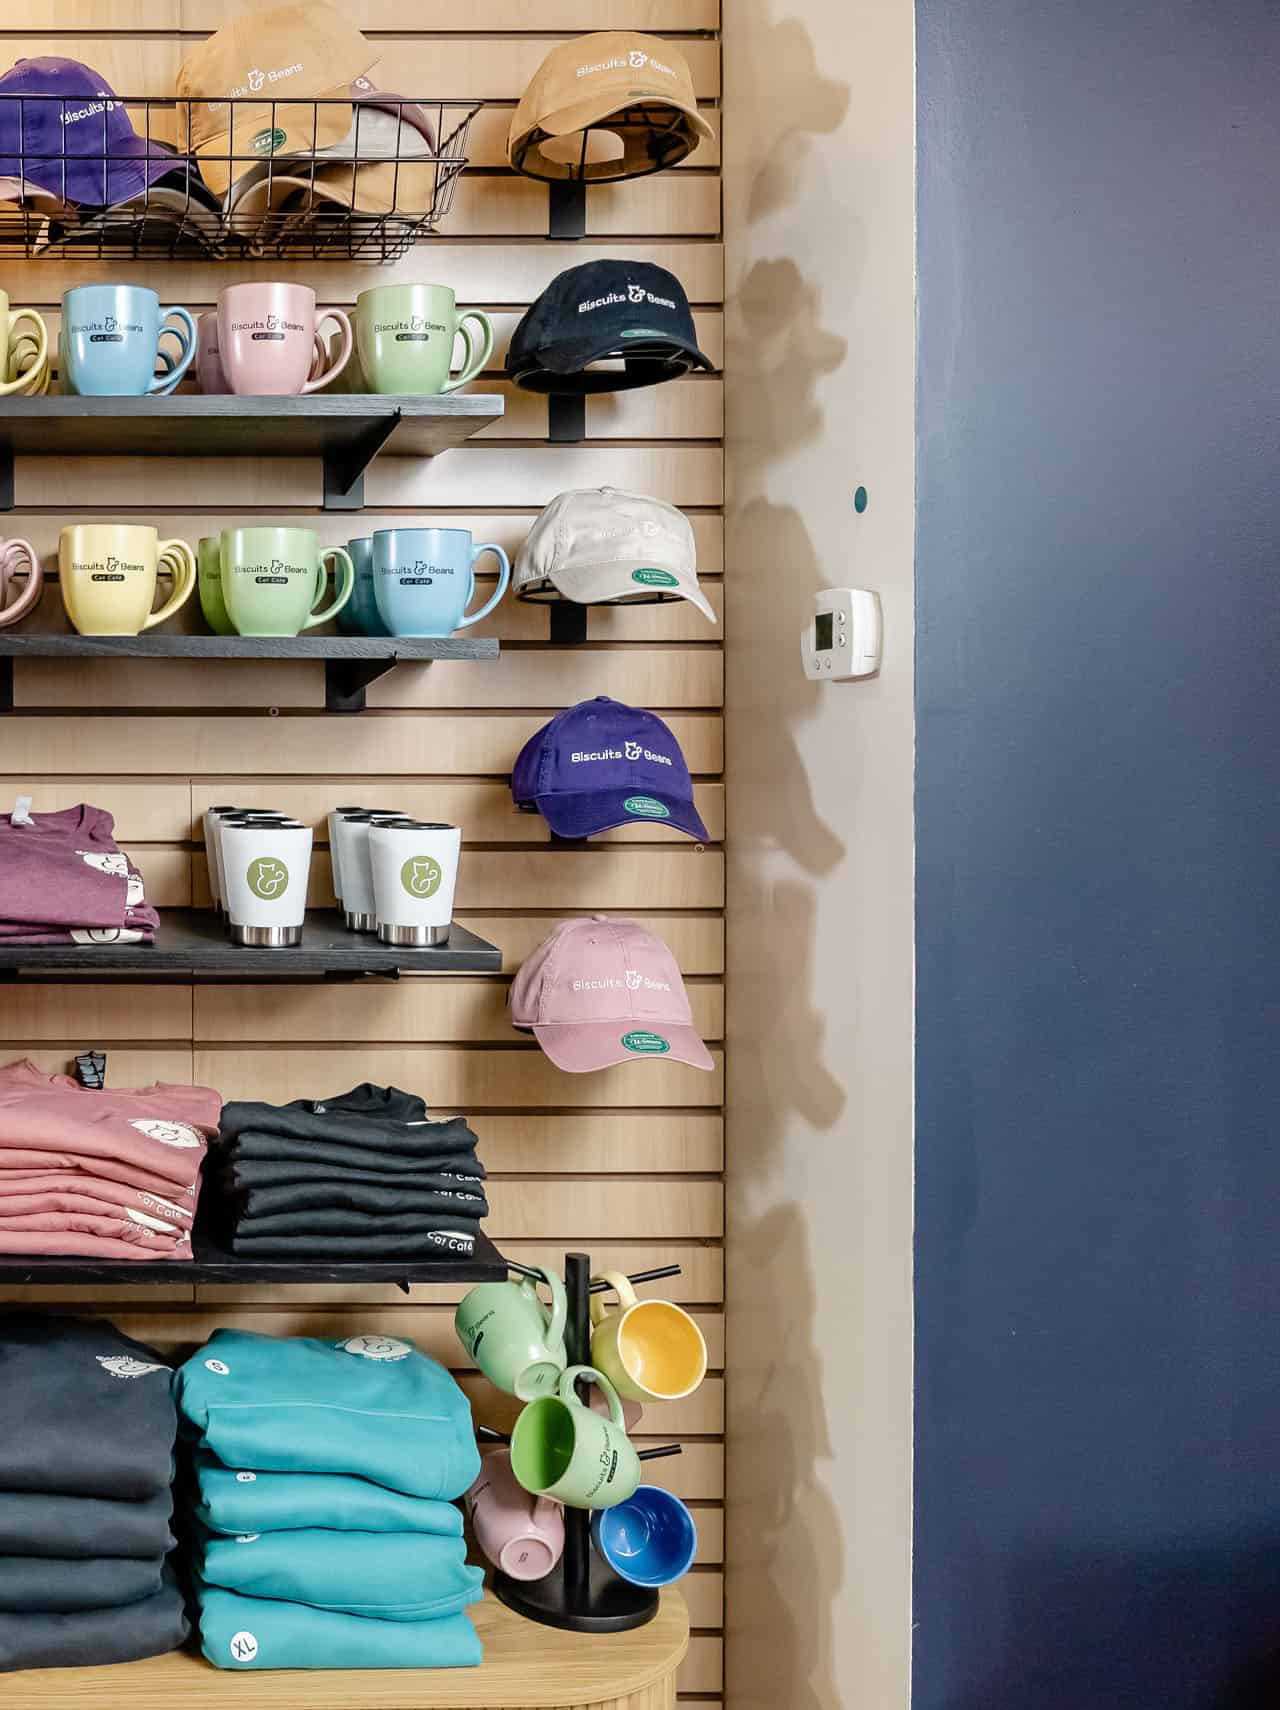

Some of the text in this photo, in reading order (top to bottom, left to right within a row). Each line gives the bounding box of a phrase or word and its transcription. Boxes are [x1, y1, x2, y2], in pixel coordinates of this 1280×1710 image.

[578, 293, 626, 313] Biscuits
[231, 321, 264, 331] Biscuits
[281, 322, 304, 332] Beans
[374, 321, 409, 333] Biscuits
[425, 322, 447, 332] Beans
[120, 562, 145, 571] Beans
[284, 565, 308, 574] Beans
[428, 566, 455, 575] Beans
[571, 749, 622, 763] Biscuits
[644, 750, 673, 766] Beans
[573, 979, 623, 991] Biscuits
[427, 1232, 446, 1246] Cat
[233, 1638, 255, 1658] XL
